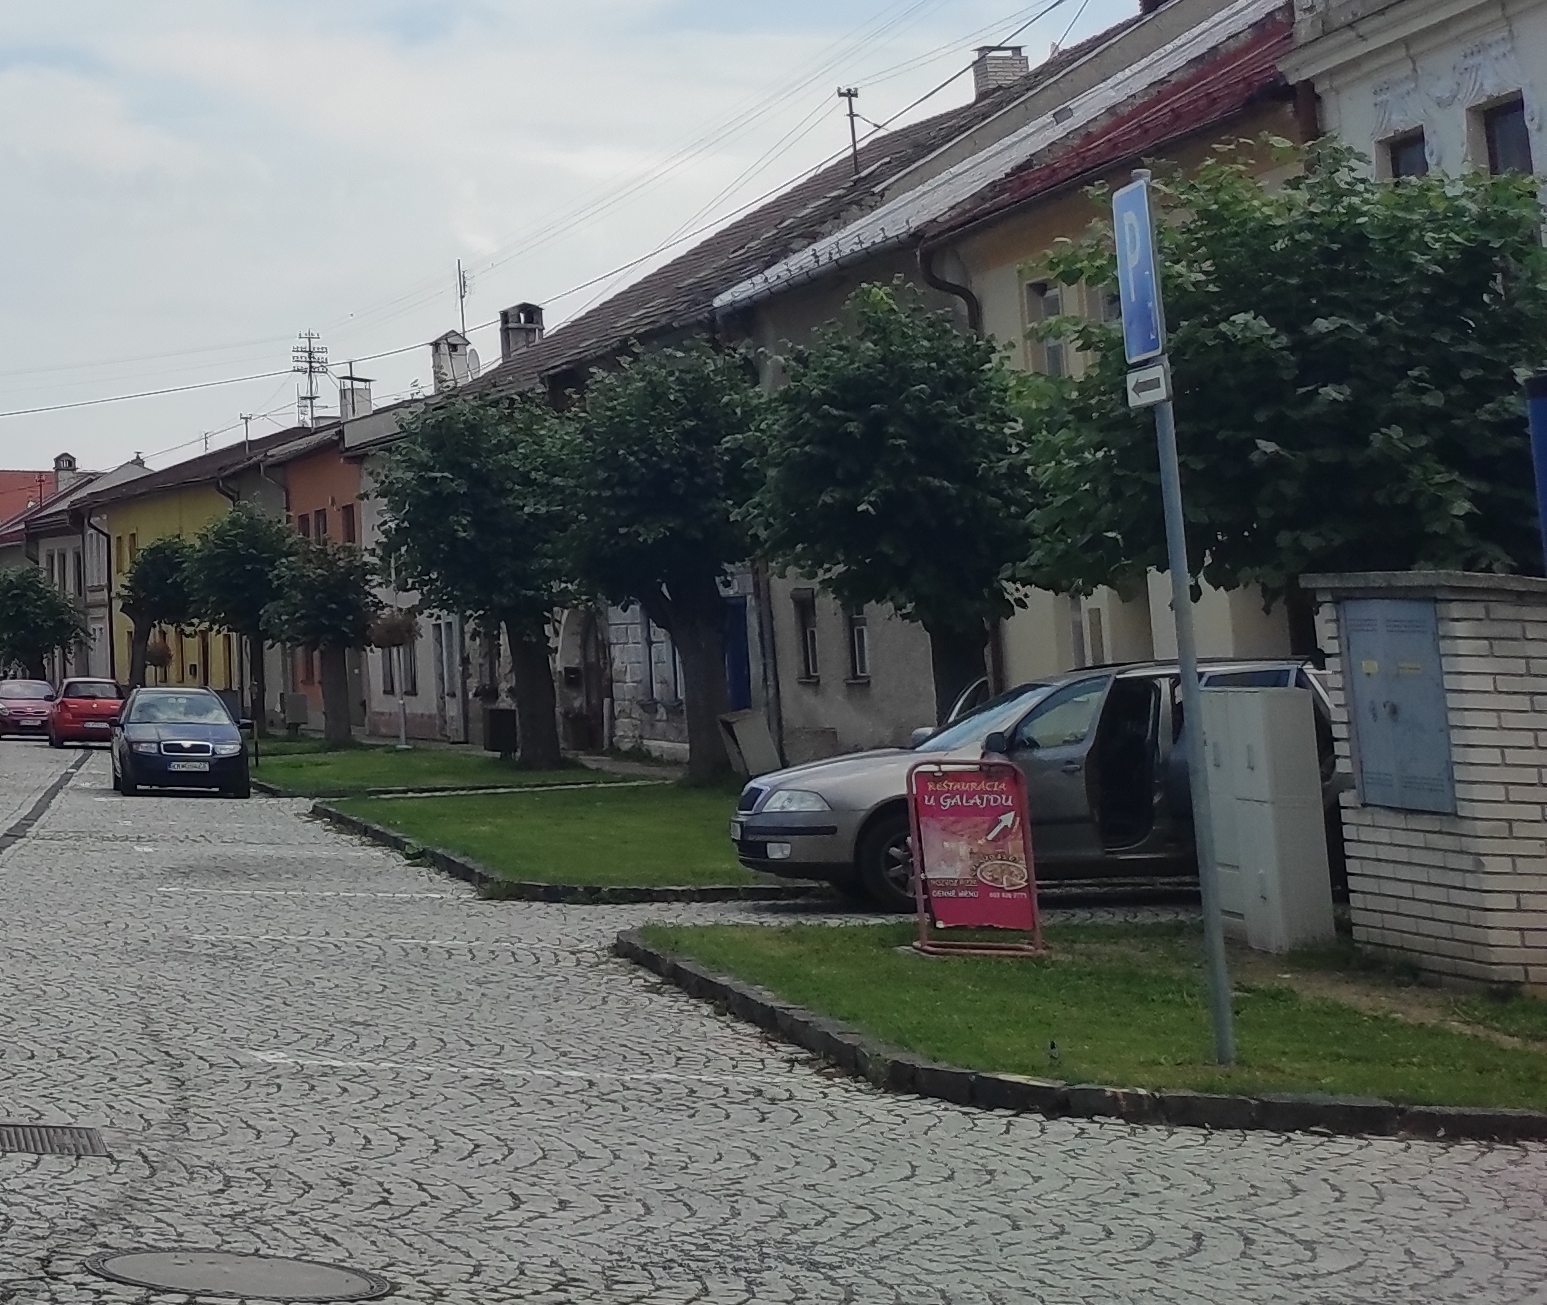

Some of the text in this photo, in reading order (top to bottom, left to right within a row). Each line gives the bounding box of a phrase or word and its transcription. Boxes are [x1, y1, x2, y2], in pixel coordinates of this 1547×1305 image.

[1123, 210, 1141, 303] P
[924, 793, 1013, 810] U GALAJDU
